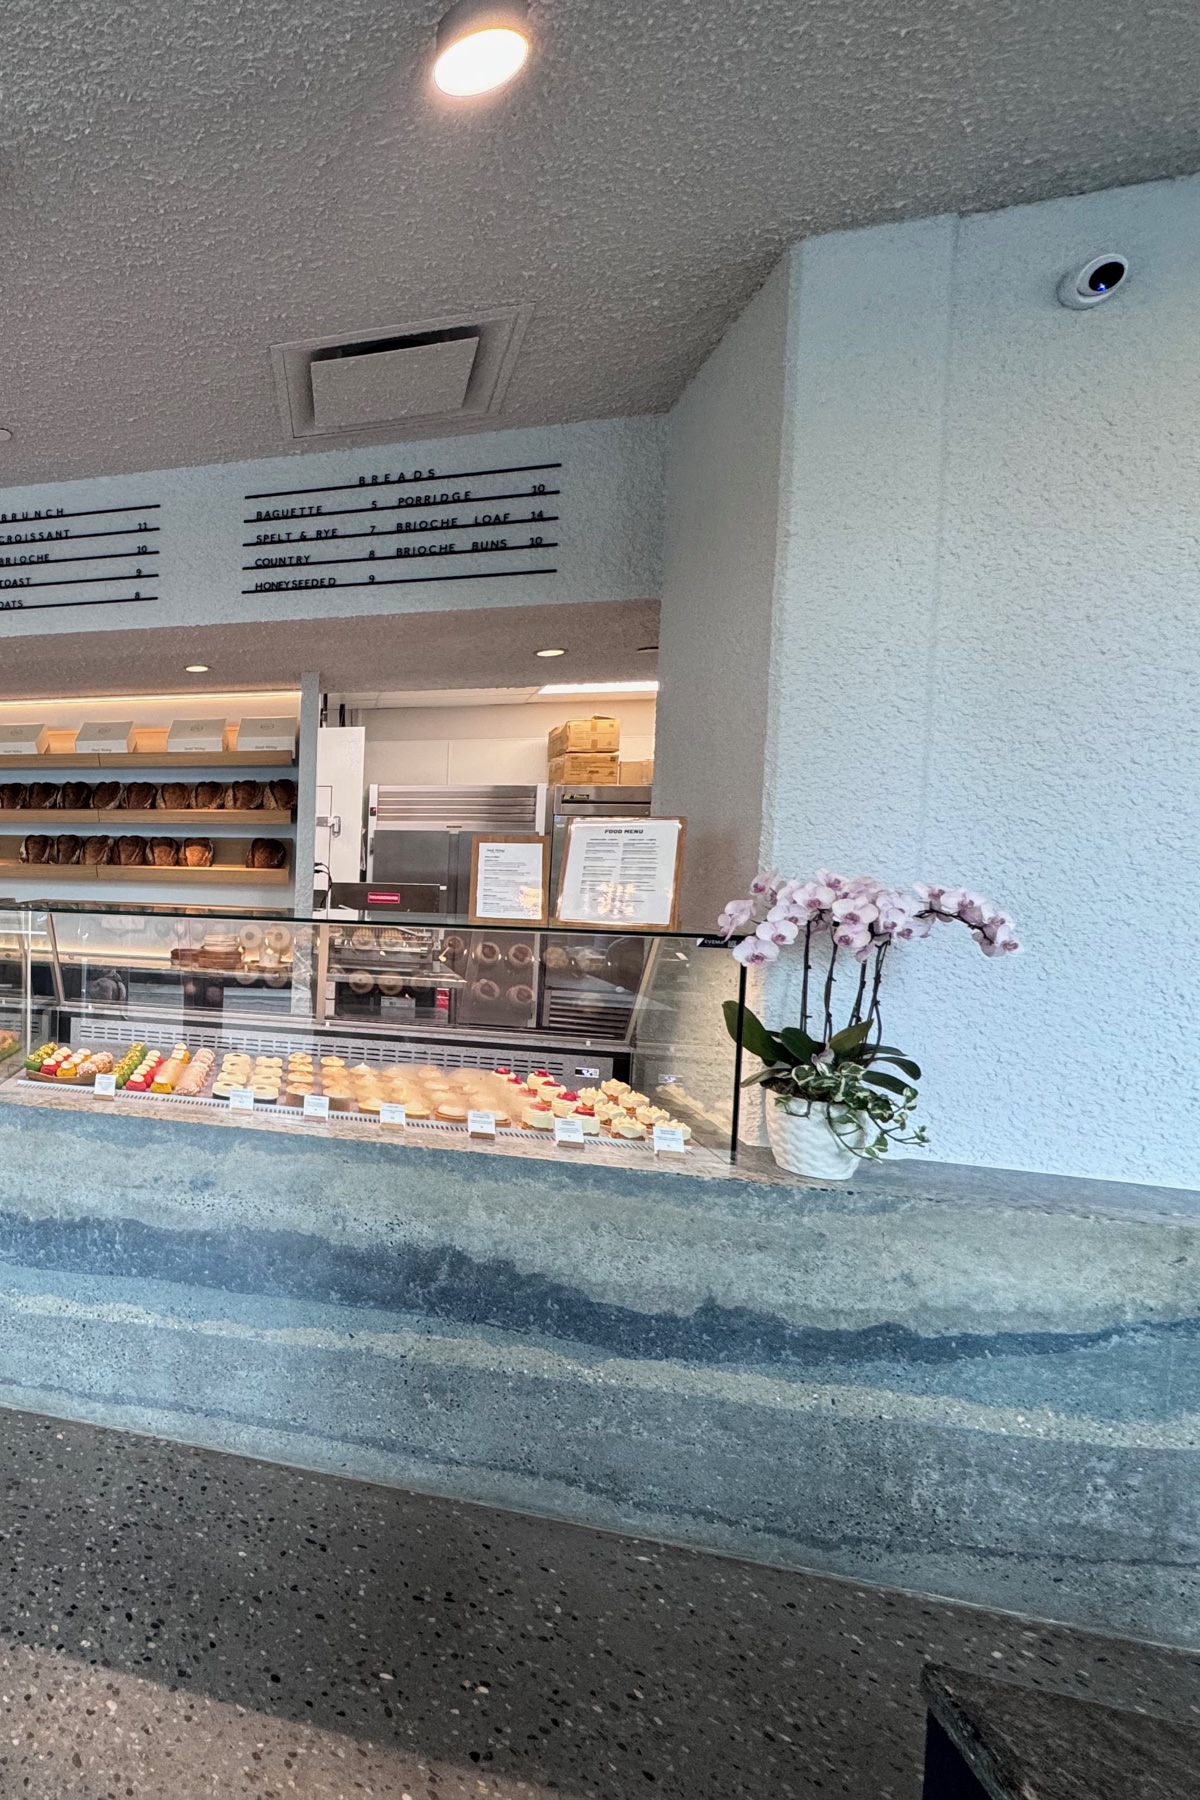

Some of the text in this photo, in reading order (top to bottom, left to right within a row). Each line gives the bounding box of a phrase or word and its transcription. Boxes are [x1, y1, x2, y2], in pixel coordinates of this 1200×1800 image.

[358, 468, 436, 486] BREADS
[397, 483, 546, 507] PORRIDGE 10
[1, 508, 65, 523] BRUNCH
[255, 500, 378, 521] BAGUETTE 5
[137, 522, 148, 531] 11
[396, 510, 544, 532] BRIOCHE LOAF 14
[255, 525, 377, 544] SPELT & RYE 7
[136, 545, 148, 554] 10
[395, 536, 543, 557] BRIOCHE BUNS 10
[254, 549, 376, 568] COUNTRY 8
[135, 568, 142, 577] 9
[368, 574, 376, 583] 9
[134, 592, 141, 600] 8
